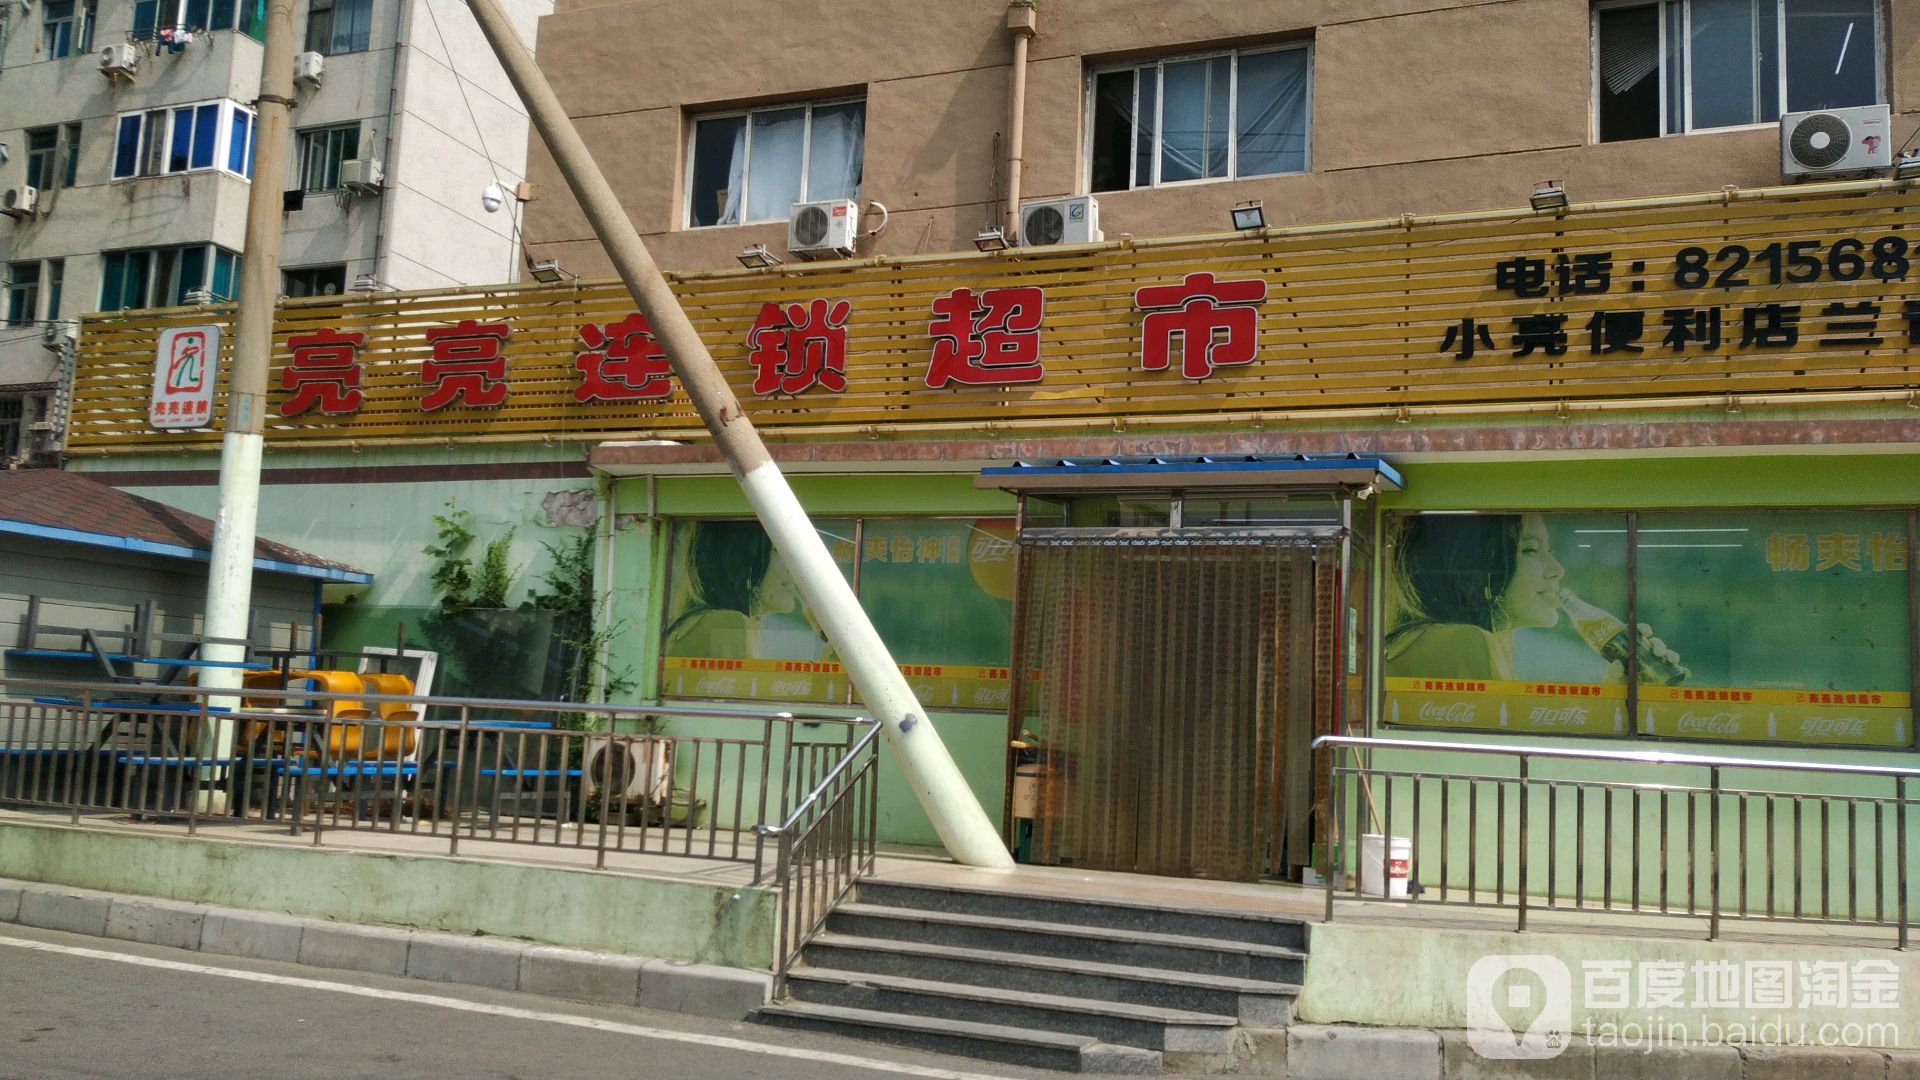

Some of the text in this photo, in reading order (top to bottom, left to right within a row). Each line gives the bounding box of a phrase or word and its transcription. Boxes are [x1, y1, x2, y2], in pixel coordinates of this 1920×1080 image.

[1496, 236, 1920, 298] 电话：821568
[280, 271, 1268, 417] 亮亮连锁超市
